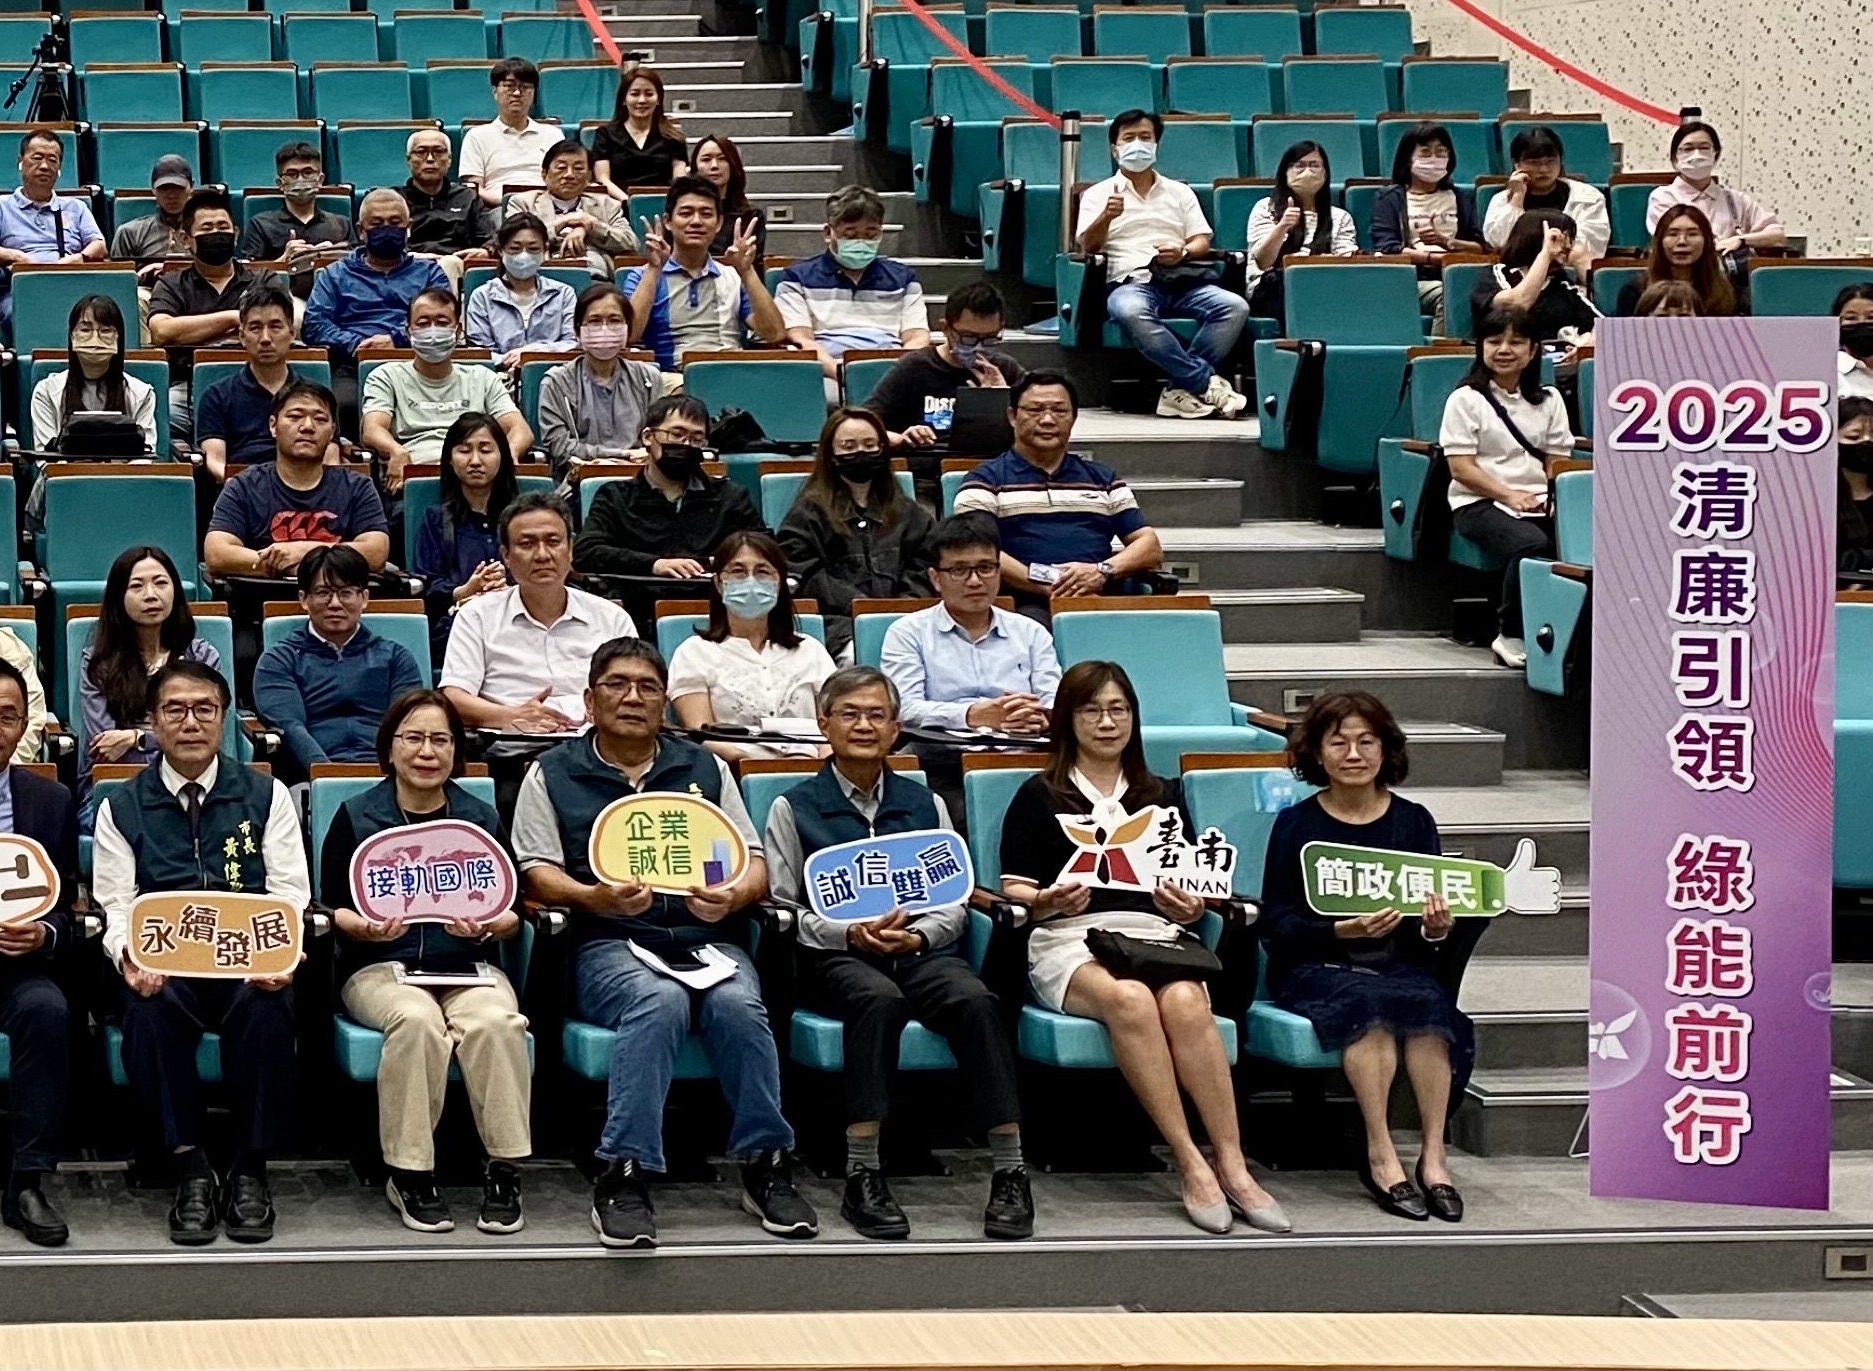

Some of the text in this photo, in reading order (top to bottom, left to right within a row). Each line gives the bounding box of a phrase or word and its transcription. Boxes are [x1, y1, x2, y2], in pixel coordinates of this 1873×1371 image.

[1615, 383, 1827, 449] 2025
[1674, 466, 1754, 788] 清廉引領
[625, 810, 690, 842] 企業
[1146, 811, 1233, 872] 臺南
[367, 859, 497, 899] 接軌國際
[627, 845, 692, 876] 誠信
[816, 842, 963, 908] 誠信雙贏
[1152, 874, 1228, 895] TINAN
[1314, 856, 1477, 909] 簡政便民
[139, 904, 292, 968] 永續發展
[1669, 839, 1753, 1162] 綠能前行
